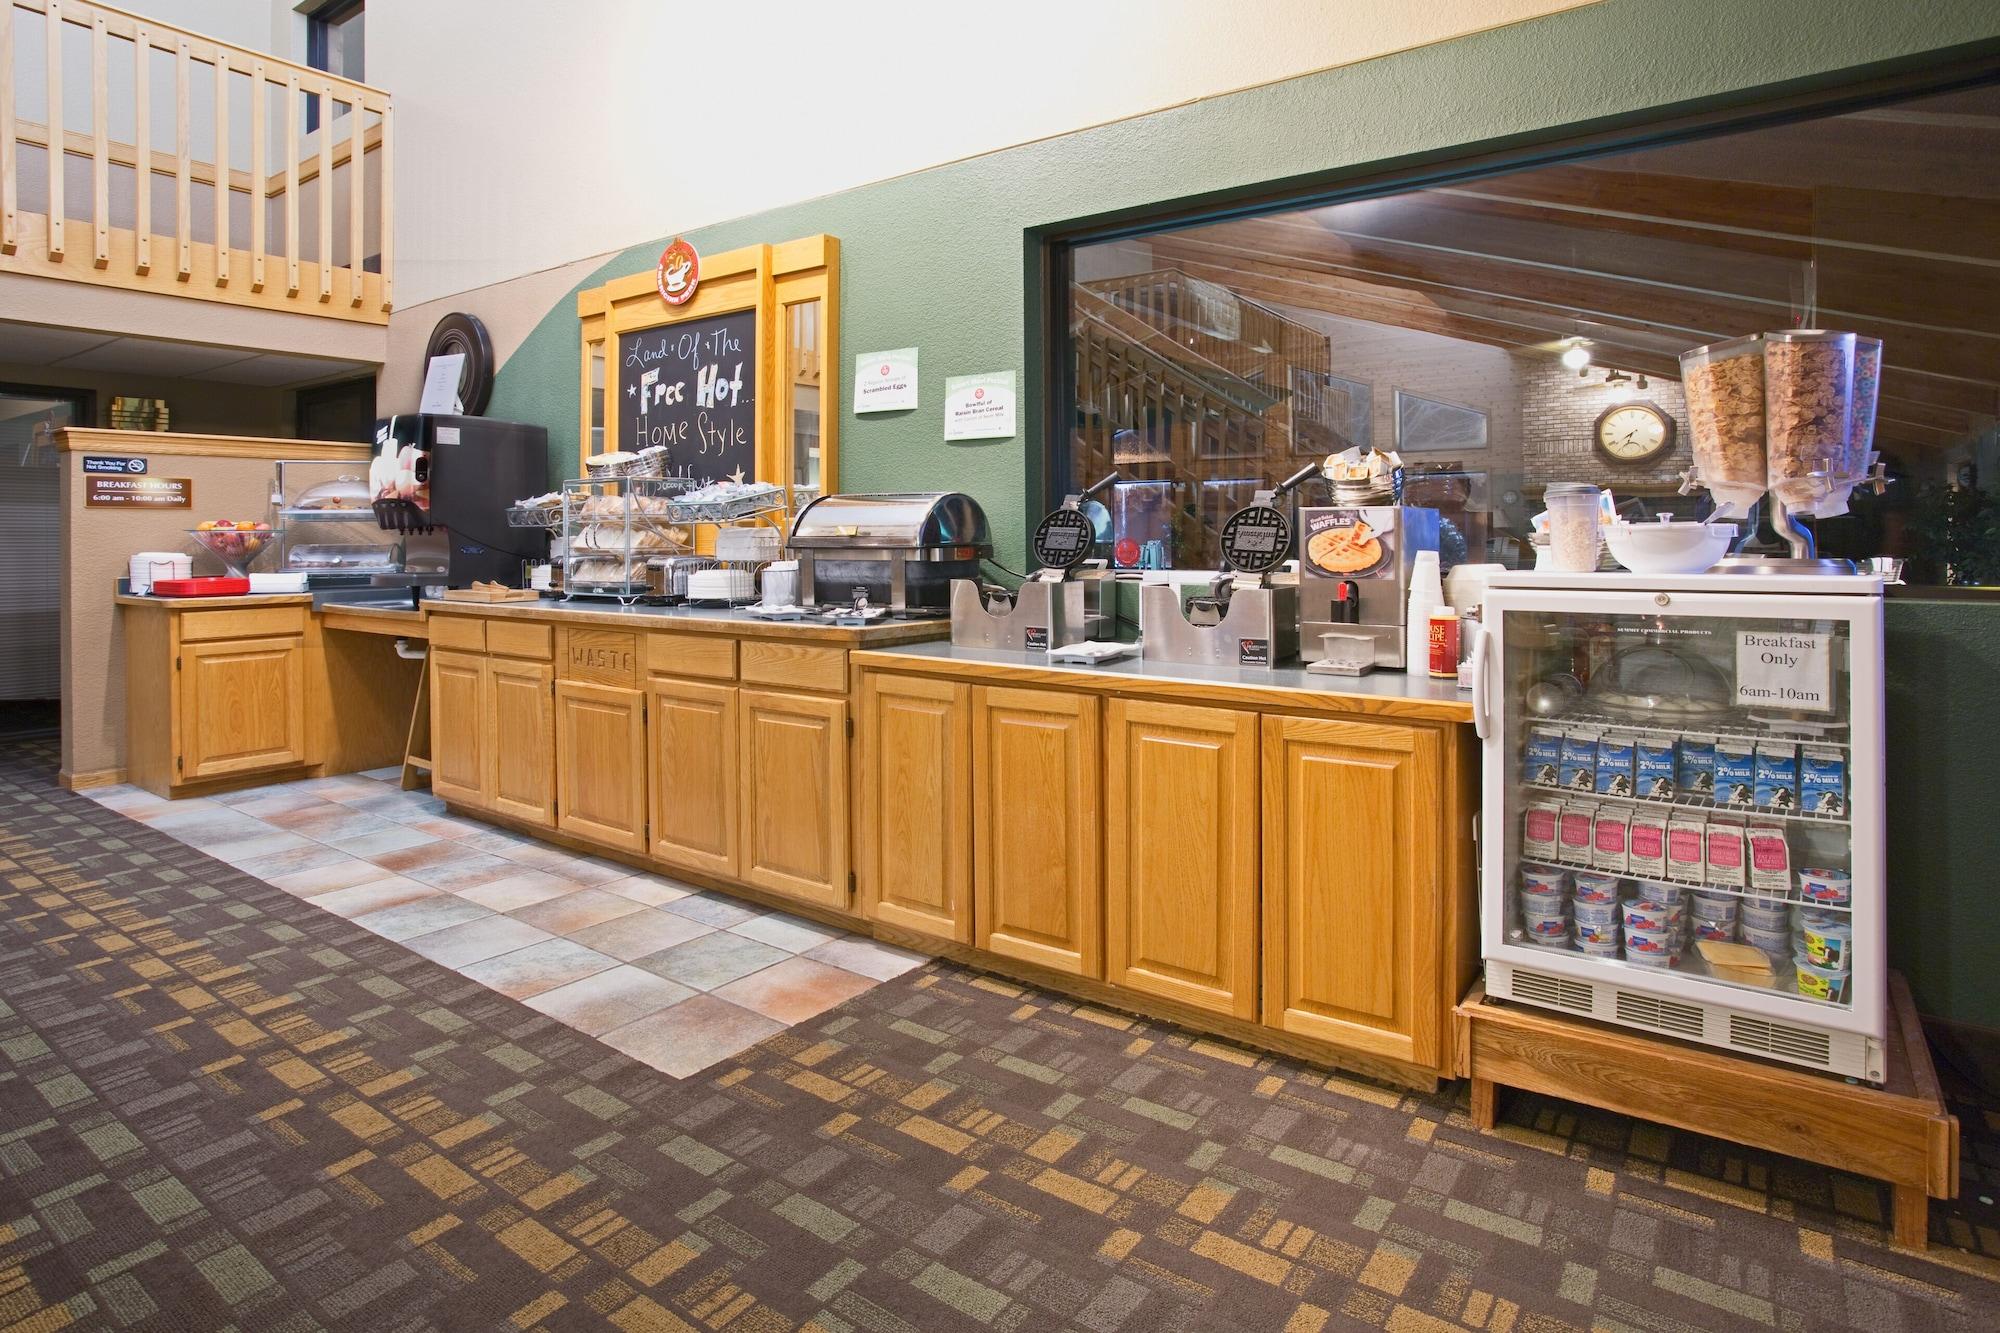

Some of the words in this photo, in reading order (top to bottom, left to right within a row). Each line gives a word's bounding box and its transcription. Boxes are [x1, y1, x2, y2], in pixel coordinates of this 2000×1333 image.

[626, 337, 668, 368] Land
[678, 332, 701, 370] Of
[711, 328, 742, 356] The
[640, 367, 686, 414] Free
[863, 384, 891, 395] Scrambled
[892, 383, 907, 391] Eggs
[697, 411, 747, 456] Style
[96, 480, 146, 489] BREAKFAST
[167, 495, 186, 504] Daily
[1310, 518, 1350, 531] WAFFLES
[1430, 624, 1445, 634] USE
[1745, 634, 1816, 649] Breakfast
[571, 647, 632, 672] WASTE
[1761, 652, 1798, 668] Only
[1740, 684, 1819, 701] 6am-10am
[1528, 747, 1542, 756] 2%
[1562, 751, 1577, 761] 2%
[1599, 757, 1614, 767] 2%
[1640, 760, 1655, 769] 2%
[1683, 755, 1697, 764] 2%
[1717, 766, 1734, 777] 2%
[1759, 769, 1775, 779] 2%
[1803, 773, 1821, 783] 2%
